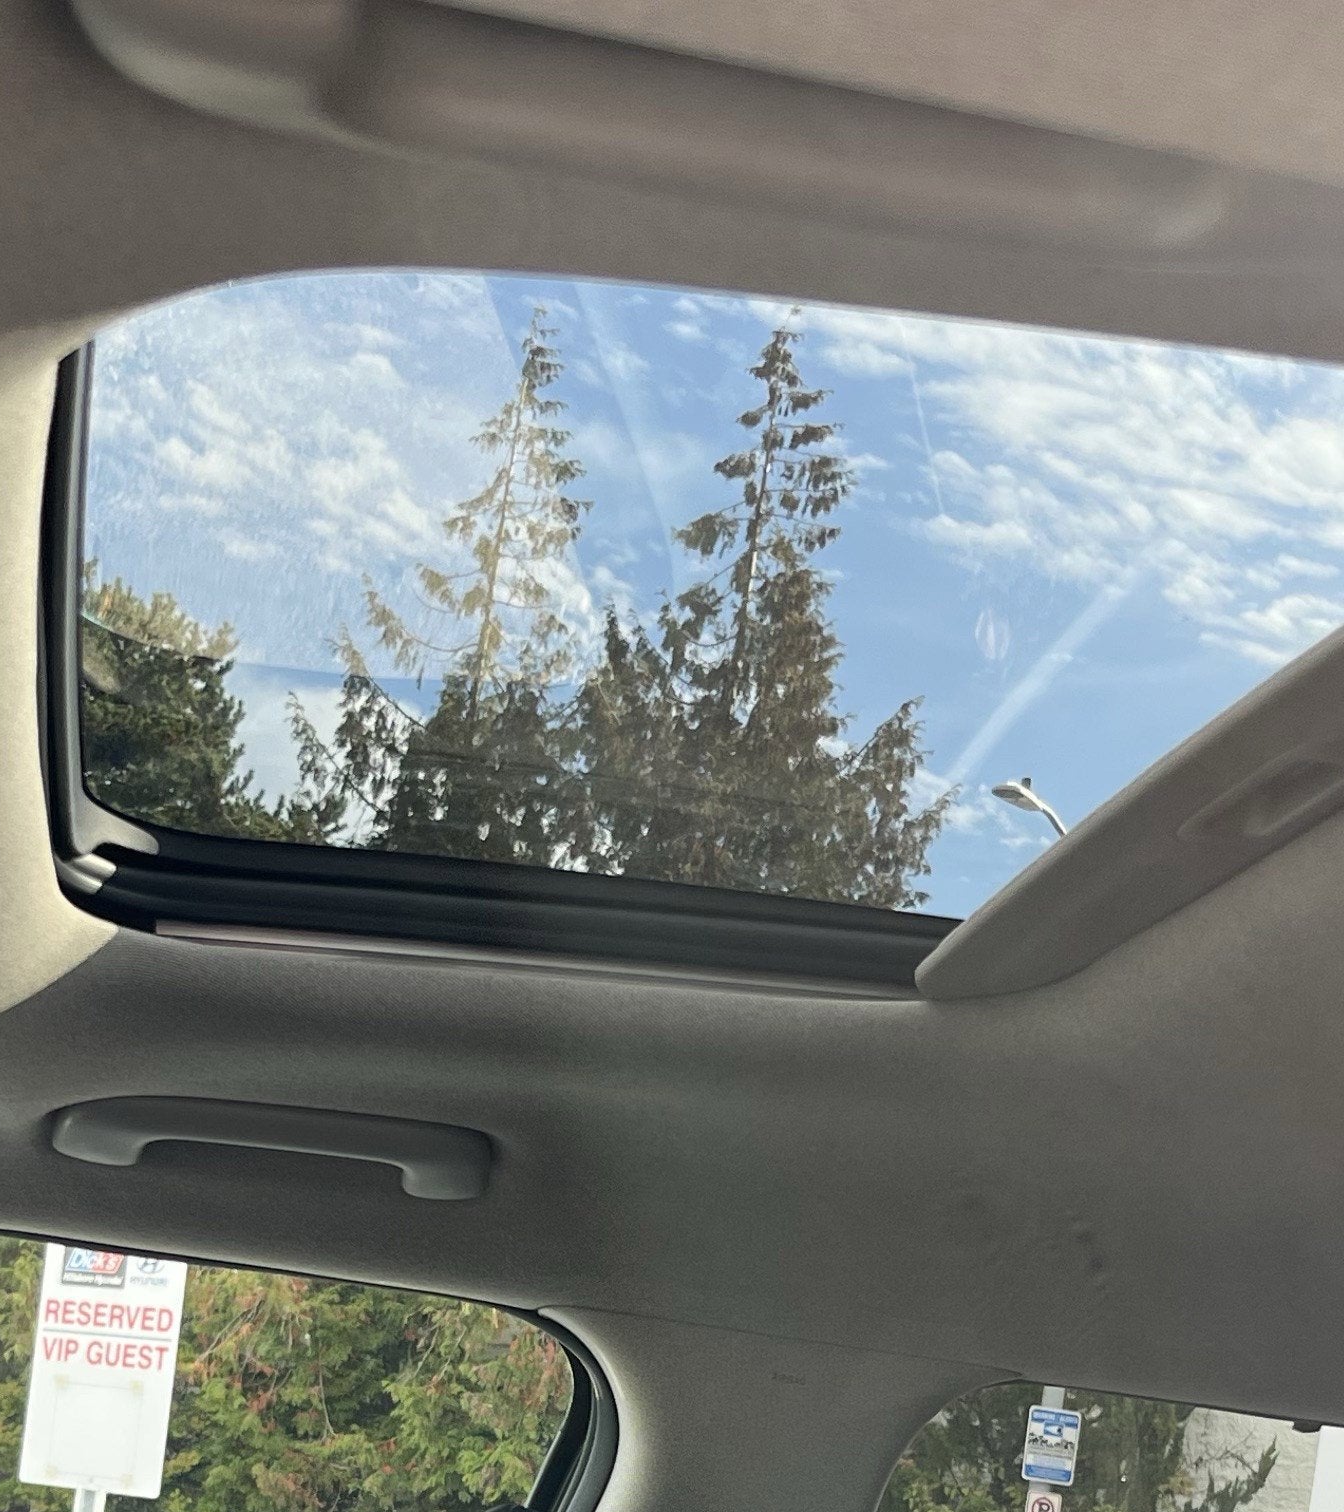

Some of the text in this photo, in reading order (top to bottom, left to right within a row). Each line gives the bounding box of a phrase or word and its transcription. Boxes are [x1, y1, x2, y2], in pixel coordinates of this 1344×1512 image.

[44, 1299, 174, 1332] RESERVED
[43, 1337, 169, 1371] VIP GUEST
